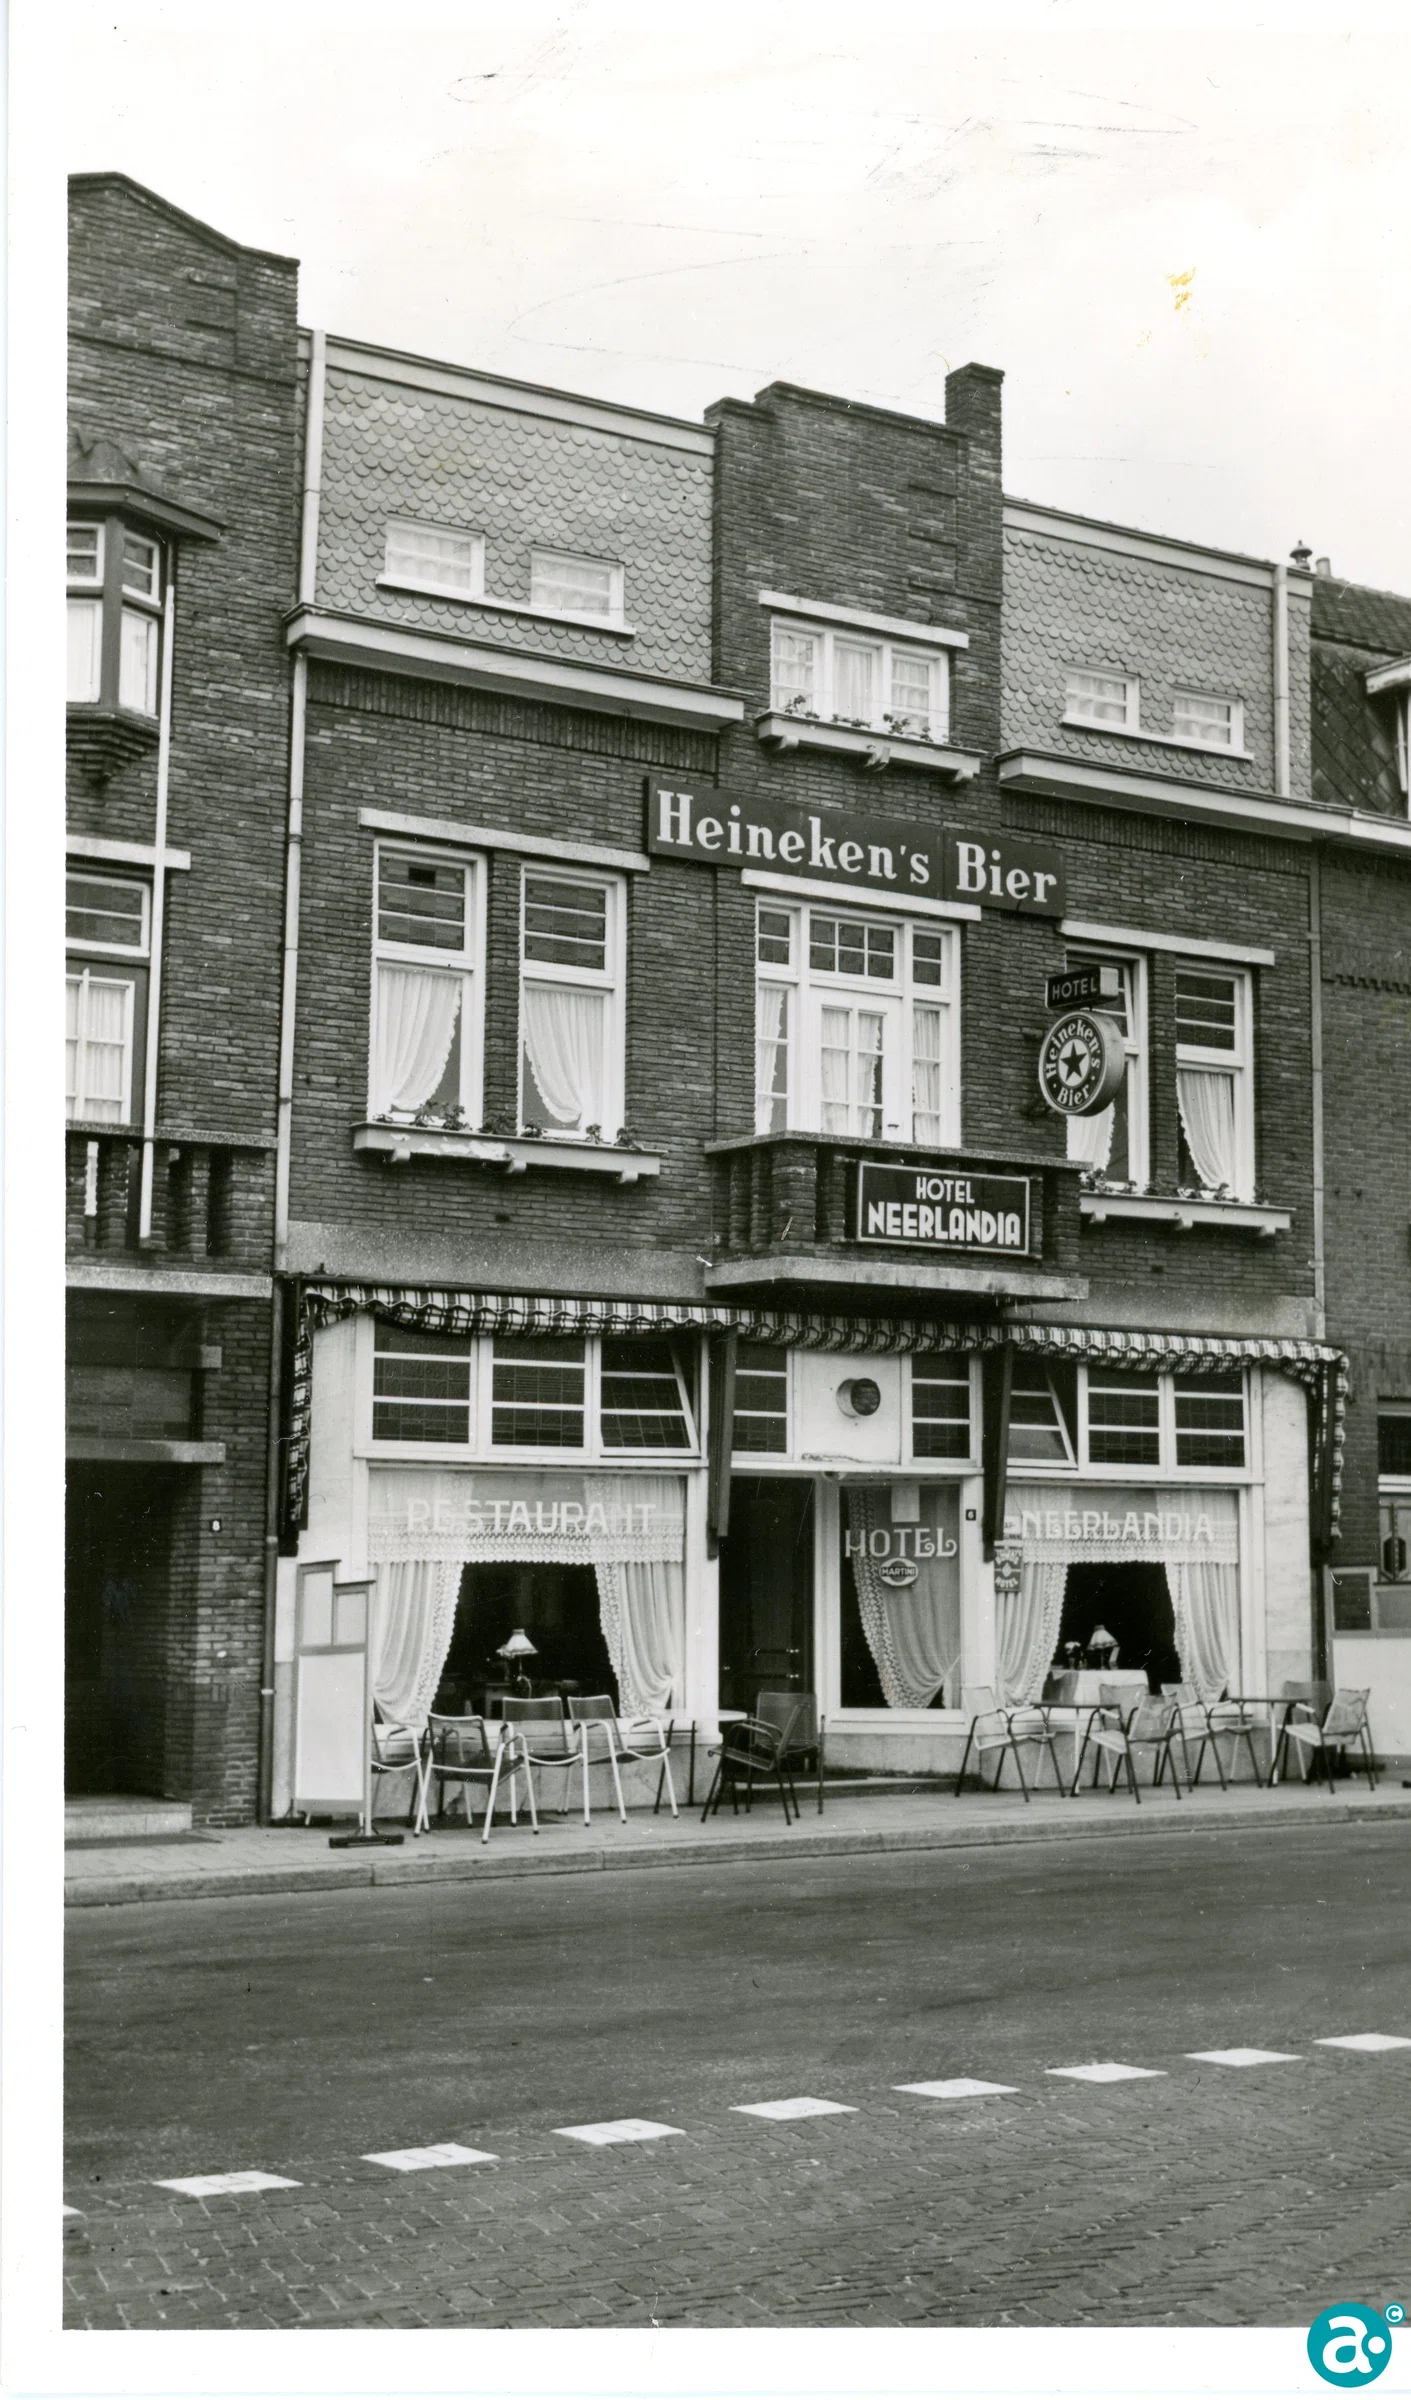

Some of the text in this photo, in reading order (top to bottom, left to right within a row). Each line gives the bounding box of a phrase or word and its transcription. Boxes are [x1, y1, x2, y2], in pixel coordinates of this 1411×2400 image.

[656, 789, 1057, 903] Heineken's Bier
[1052, 976, 1097, 1000] HOTEL
[1046, 1019, 1101, 1079] Heineken's
[1057, 1084, 1090, 1106] Bier
[916, 1176, 975, 1204] HOTEL
[868, 1201, 1021, 1246] NEERLANDIA
[406, 1498, 657, 1534] RESTAURANT
[967, 1510, 975, 1519] 6
[1022, 1510, 1215, 1542] NEERLANDIA
[844, 1527, 958, 1558] HOTEL
[881, 1567, 916, 1577] MARTINI
